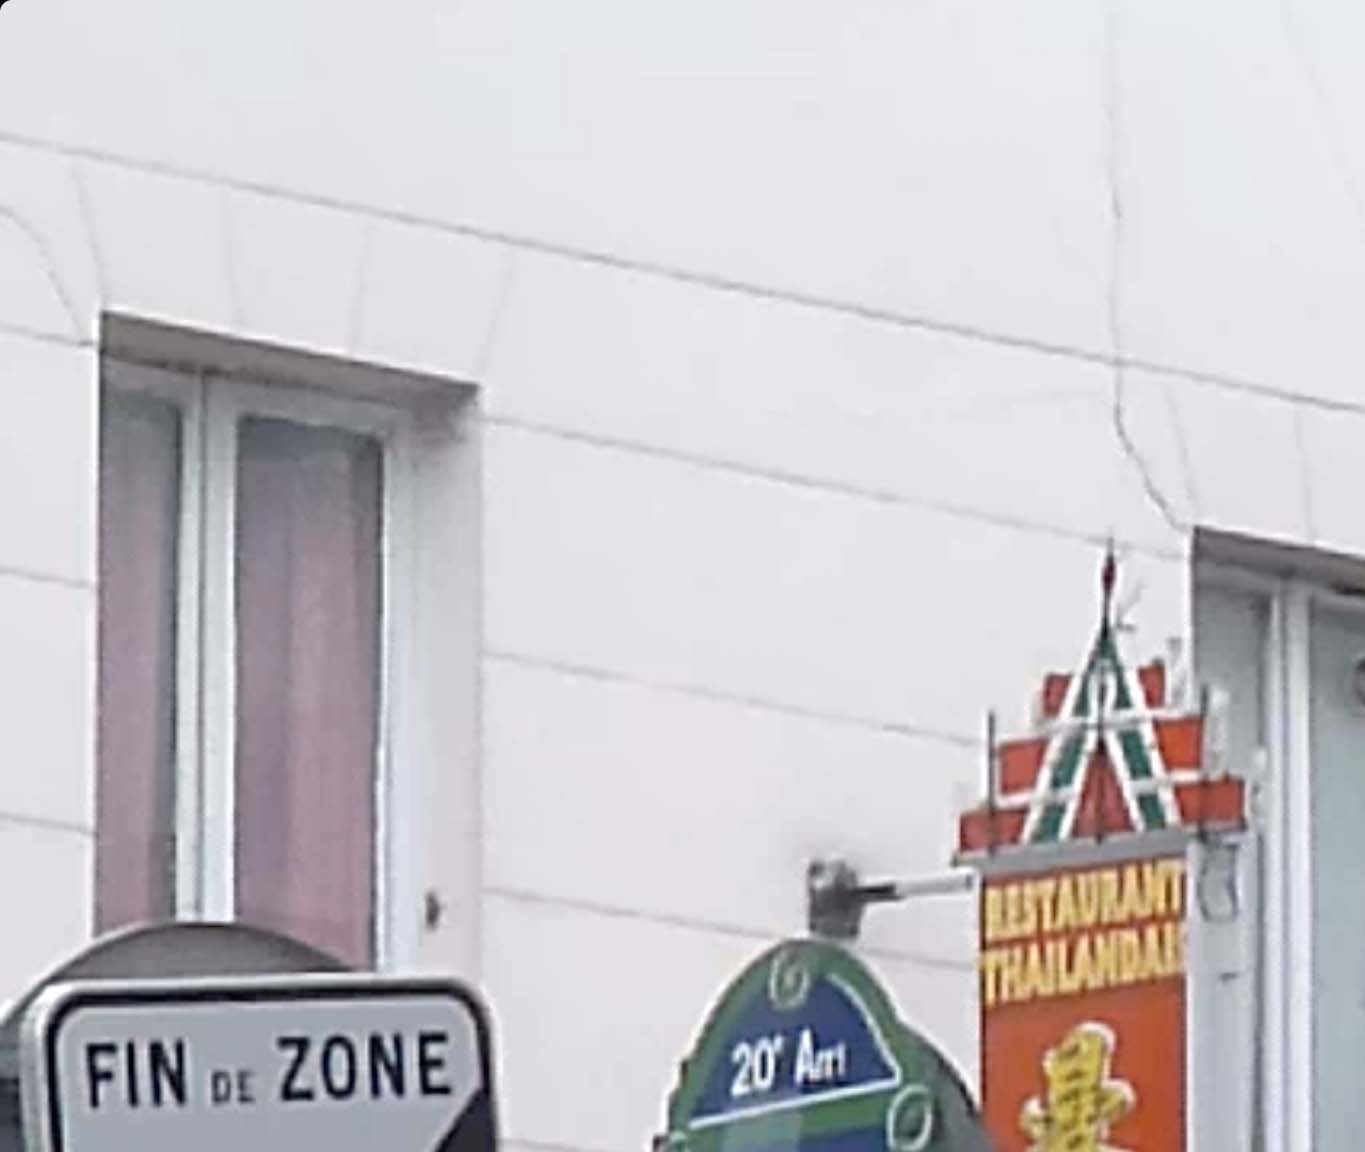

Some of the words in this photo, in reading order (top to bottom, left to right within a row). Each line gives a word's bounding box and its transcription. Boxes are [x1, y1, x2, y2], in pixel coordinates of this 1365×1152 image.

[985, 859, 1187, 941] RESTAURANT
[86, 1038, 188, 1108] FIN
[211, 1070, 256, 1106] DE
[277, 1031, 453, 1101] ZONE
